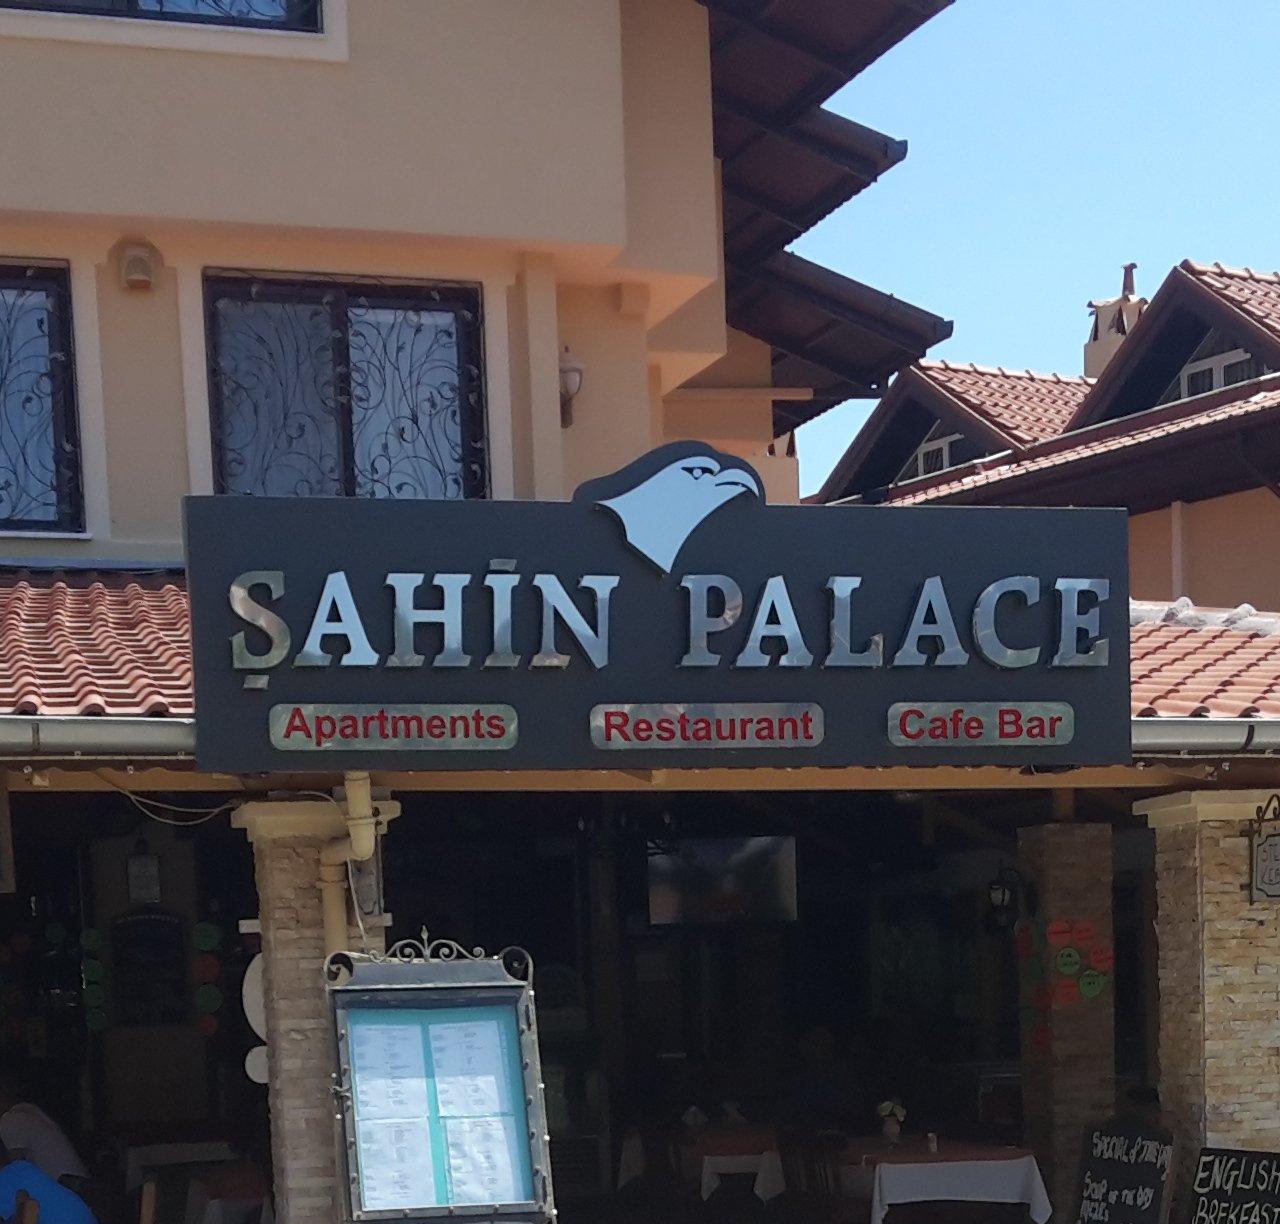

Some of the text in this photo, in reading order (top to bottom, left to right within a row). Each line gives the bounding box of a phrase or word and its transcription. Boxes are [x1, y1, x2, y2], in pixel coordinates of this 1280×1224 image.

[227, 558, 1111, 689] ŞAHİN PALACE
[283, 706, 507, 748] Apartments
[604, 709, 815, 742] Restaurant
[898, 708, 1063, 740] Cafe Bar
